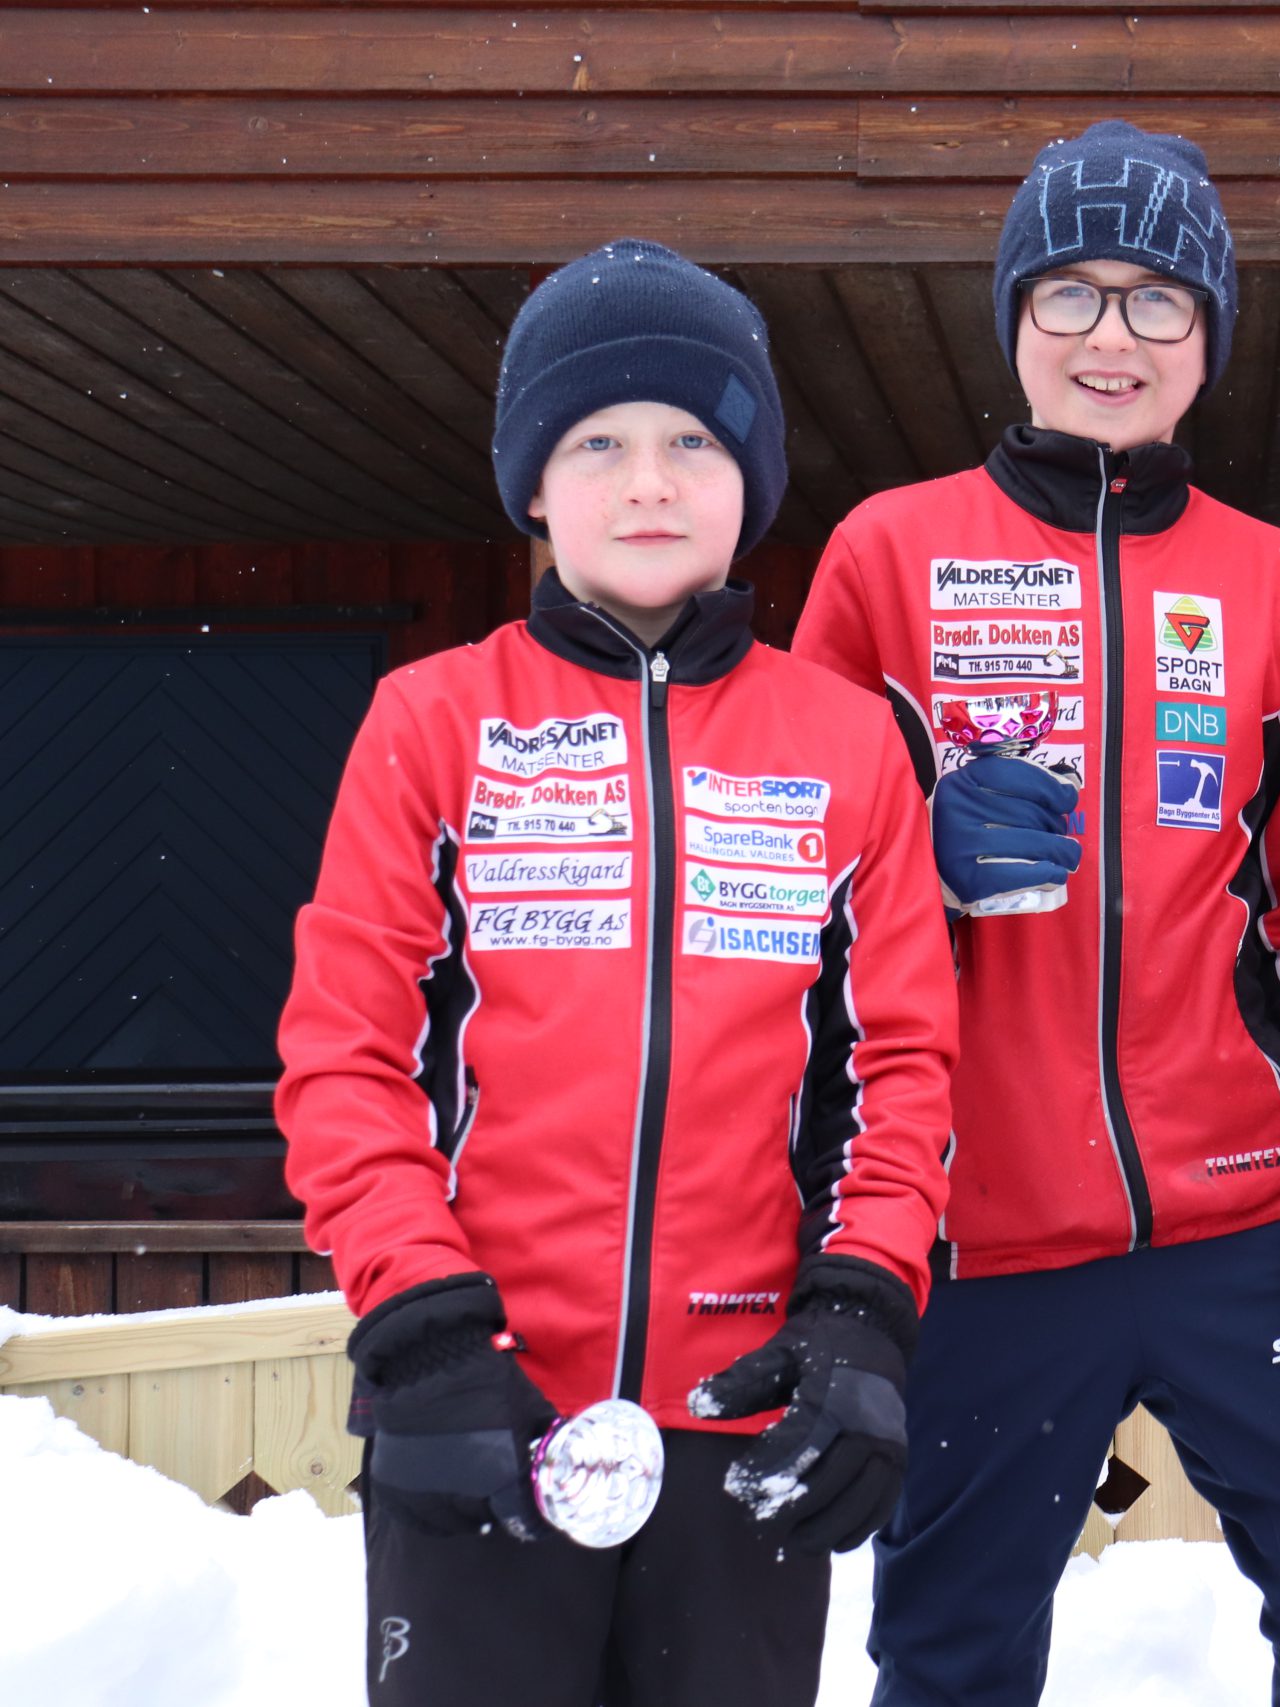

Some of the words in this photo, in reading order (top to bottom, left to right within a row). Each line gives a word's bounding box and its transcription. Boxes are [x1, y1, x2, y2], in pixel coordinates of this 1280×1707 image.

[954, 592, 1061, 607] MATSENTER
[933, 625, 983, 647] Brødr.
[988, 624, 1053, 645] Dokken
[1057, 624, 1080, 647] AS
[984, 660, 1000, 671] 915
[1003, 660, 1014, 671] 70
[1016, 660, 1032, 671] 440
[1157, 657, 1222, 679] SPORT
[1169, 677, 1211, 692] BAGN
[1164, 704, 1219, 741] DNB
[501, 750, 605, 775] MATSENTER
[474, 780, 526, 810] Brødr.
[531, 782, 597, 806] Dokken
[603, 779, 626, 805] AS
[708, 773, 825, 799] INTERSPORT
[724, 801, 782, 814] sporten
[1212, 812, 1220, 820] AS
[524, 819, 541, 830] 915
[544, 820, 556, 831] 70
[558, 821, 576, 832] 440
[689, 842, 746, 858] HALLINGDAL
[750, 850, 795, 862] VALDRES
[704, 826, 794, 850] SpareBank
[805, 838, 817, 858] 1
[467, 856, 630, 887] Valdresskigard
[719, 881, 825, 906] BYGGtorget
[720, 900, 737, 908] BAGN
[740, 902, 784, 911] BYGGSENTER
[472, 905, 519, 934] FG
[521, 909, 595, 934] BYGG
[597, 912, 628, 931] AS
[490, 934, 612, 946] www.fg-bygg.no
[687, 1292, 780, 1315] TRIMTEX
